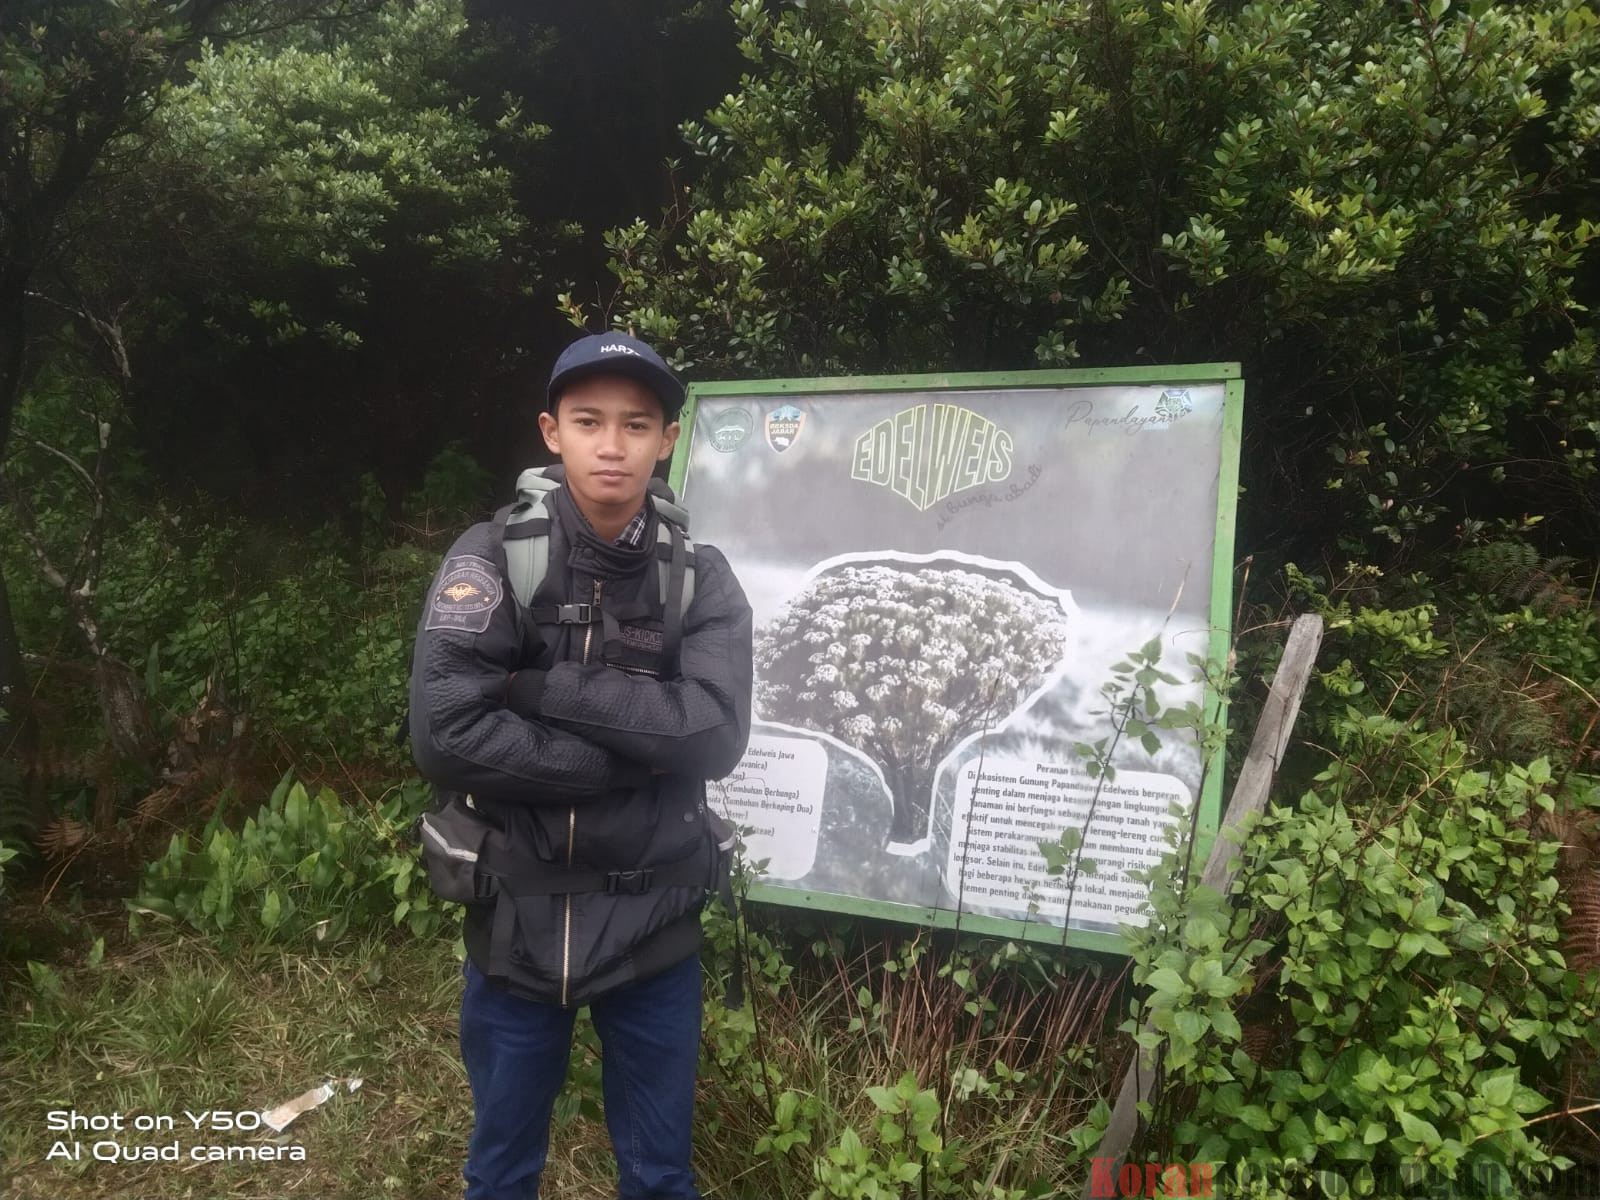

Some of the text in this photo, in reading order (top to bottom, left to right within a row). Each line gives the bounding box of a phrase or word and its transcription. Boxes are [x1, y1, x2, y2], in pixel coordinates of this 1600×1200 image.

[851, 403, 1014, 512] EDELWEIS
[747, 747, 795, 761] Edelweis Jawa
[1036, 763, 1069, 775] Peranan
[967, 770, 977, 780] Di
[979, 772, 1017, 784] ekosistem
[1019, 775, 1049, 789] Gunung
[1102, 784, 1140, 797] Edelweis
[1141, 787, 1180, 801] berperan
[971, 786, 1001, 799] penting
[1002, 787, 1026, 799] dalam
[1027, 791, 1062, 804] menjaga
[796, 803, 814, 816] Dua)
[1005, 801, 1016, 812] ini
[1017, 803, 1056, 818] berfungsi
[1126, 816, 1151, 828] tanah
[990, 814, 1014, 826] untuk
[1090, 825, 1147, 842] lereng-lereng
[992, 844, 1028, 857] stabilitas
[1099, 842, 1144, 855] membantu
[986, 856, 1010, 868] Selain
[976, 869, 1012, 883] beberapa
[989, 888, 1019, 900] penting
[1074, 898, 1113, 912] makanan
